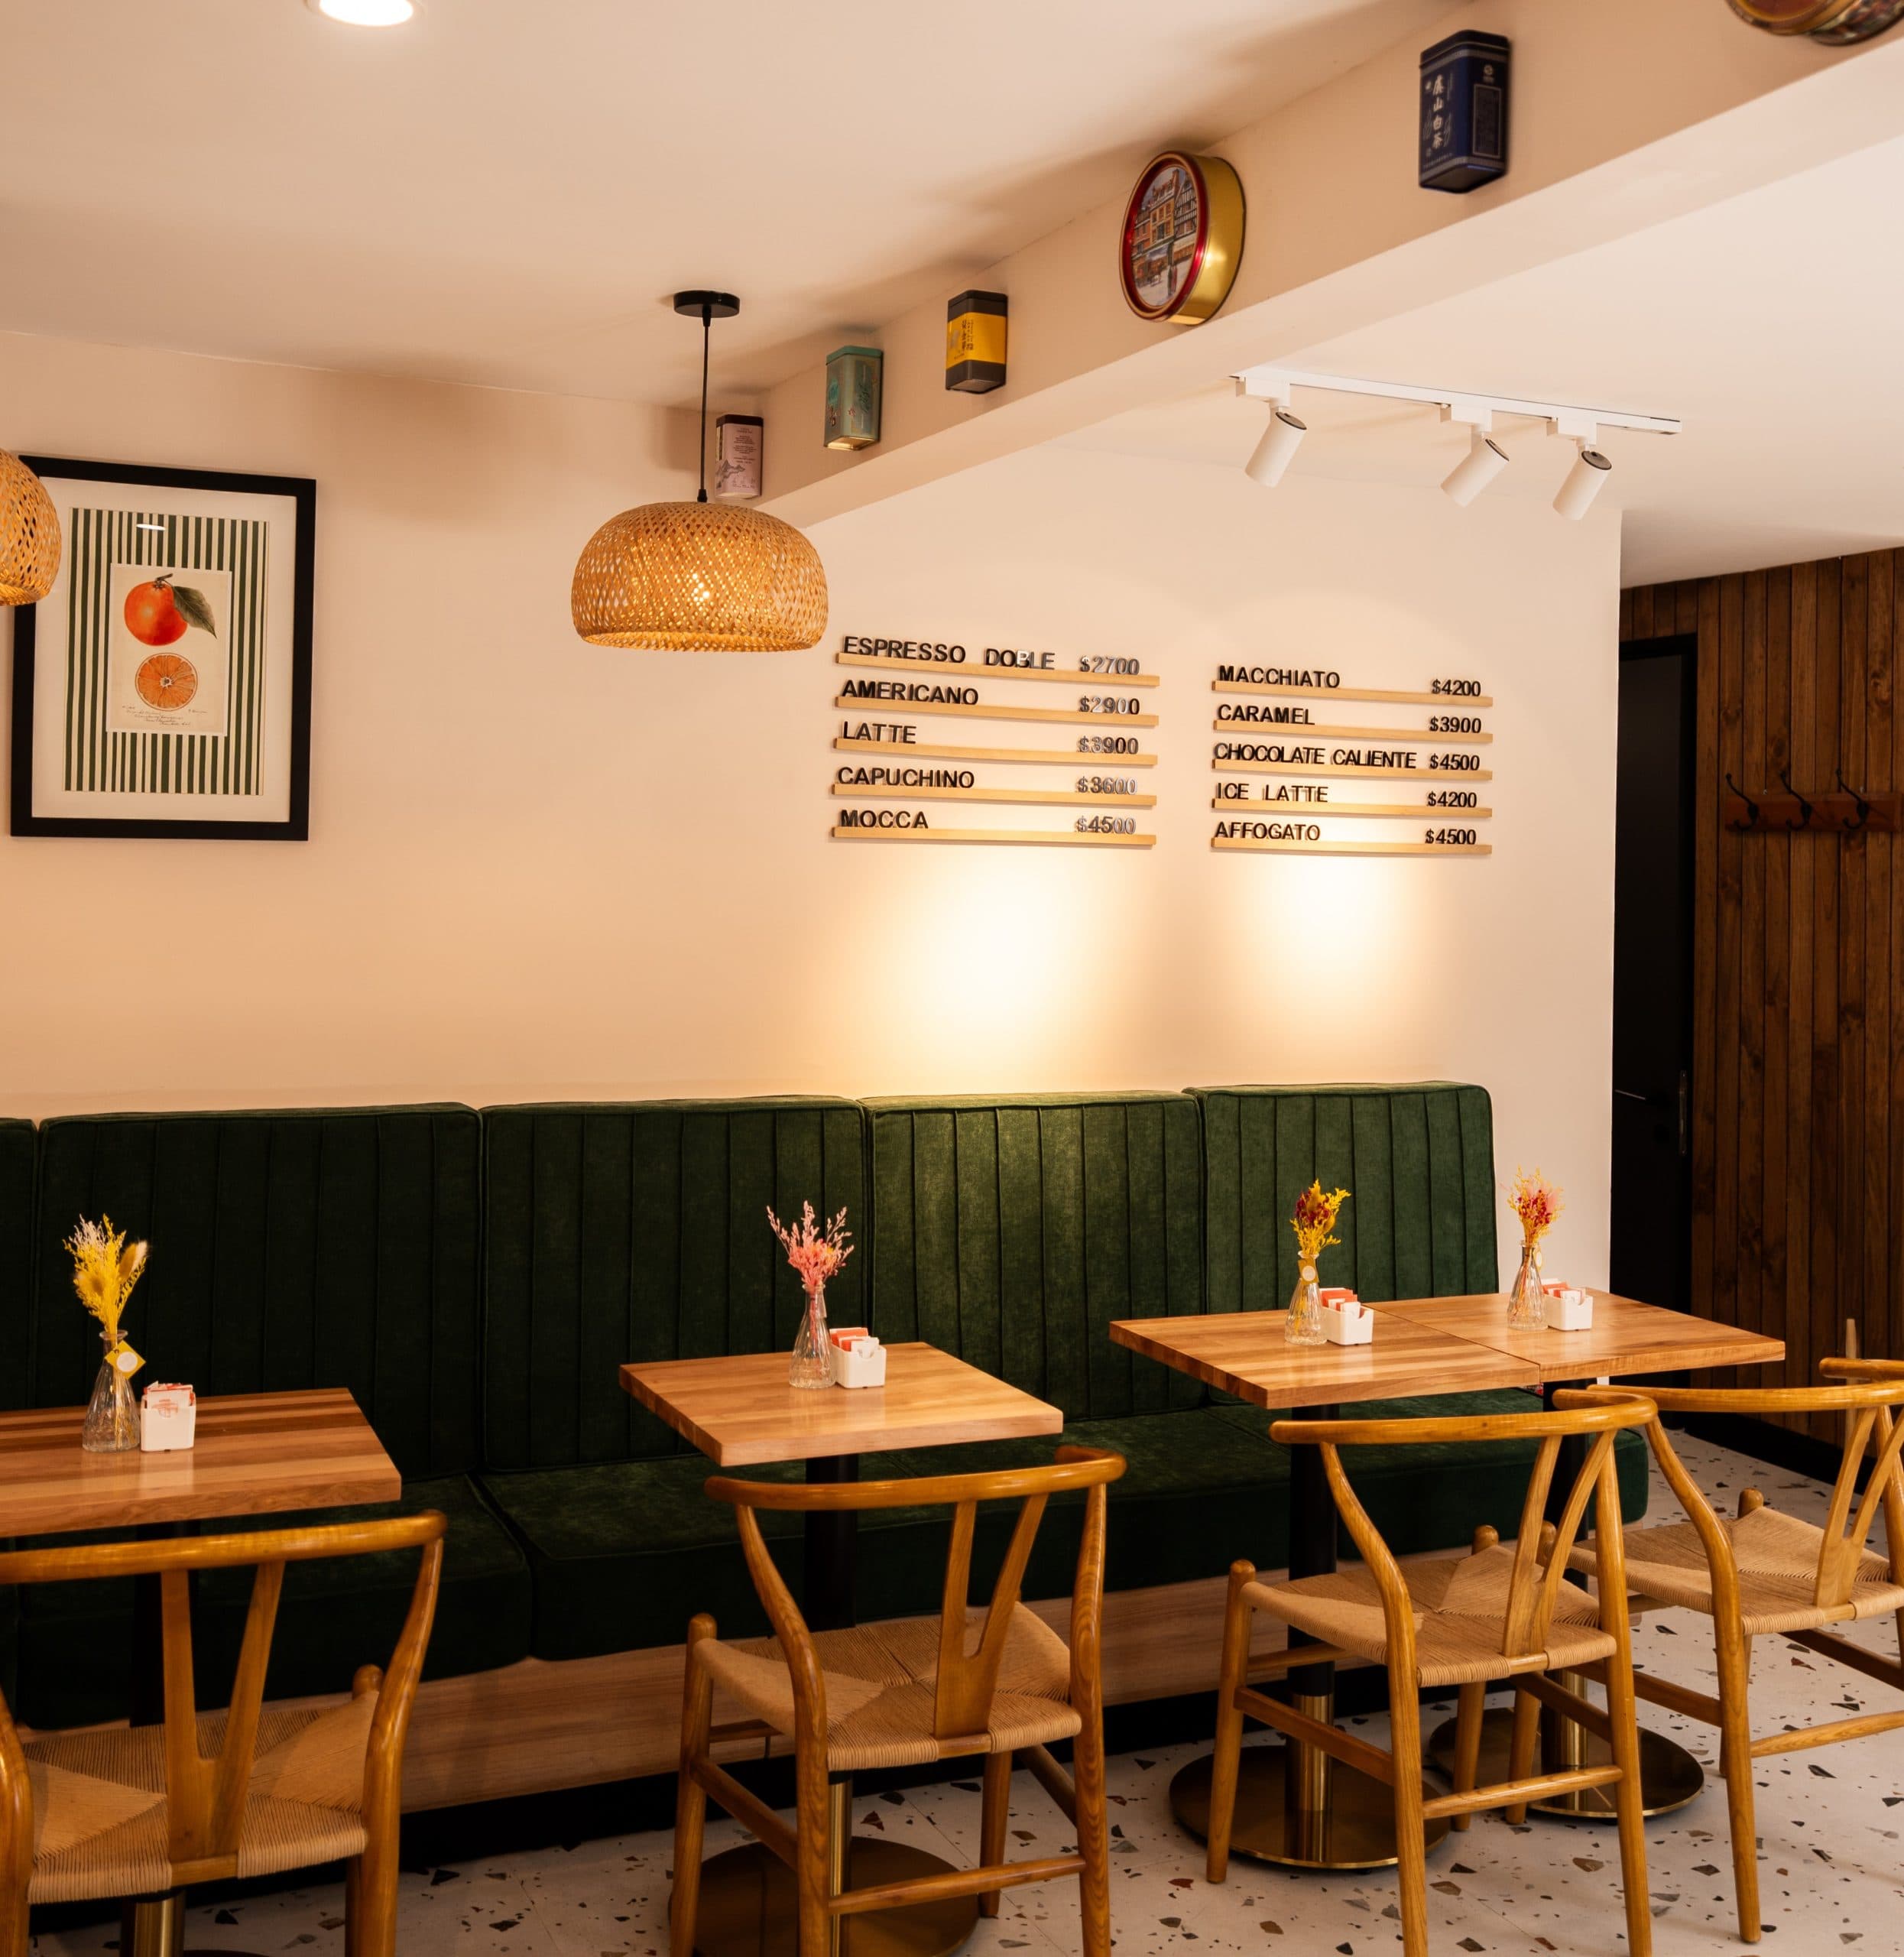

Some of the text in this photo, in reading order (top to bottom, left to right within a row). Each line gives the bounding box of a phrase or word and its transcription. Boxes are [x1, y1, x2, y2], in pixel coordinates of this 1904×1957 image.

[844, 636, 1140, 675] ESPRESSO DOBLE $2700
[1219, 666, 1481, 696] MACCHIATO $4200
[842, 680, 1140, 715] AMERICANO $2900
[1218, 704, 1481, 733] CARAMEL $3900
[843, 722, 1139, 755] LATTE $3900
[1215, 743, 1480, 771] CHOCOLATE CALIENTE $4500
[838, 768, 1137, 795] CAPUCHINO $3600
[1218, 783, 1477, 808] ICE LATTE $4200
[841, 810, 1136, 834] MOCCA $4500
[1215, 821, 1476, 845] AFFOGATO $4500
